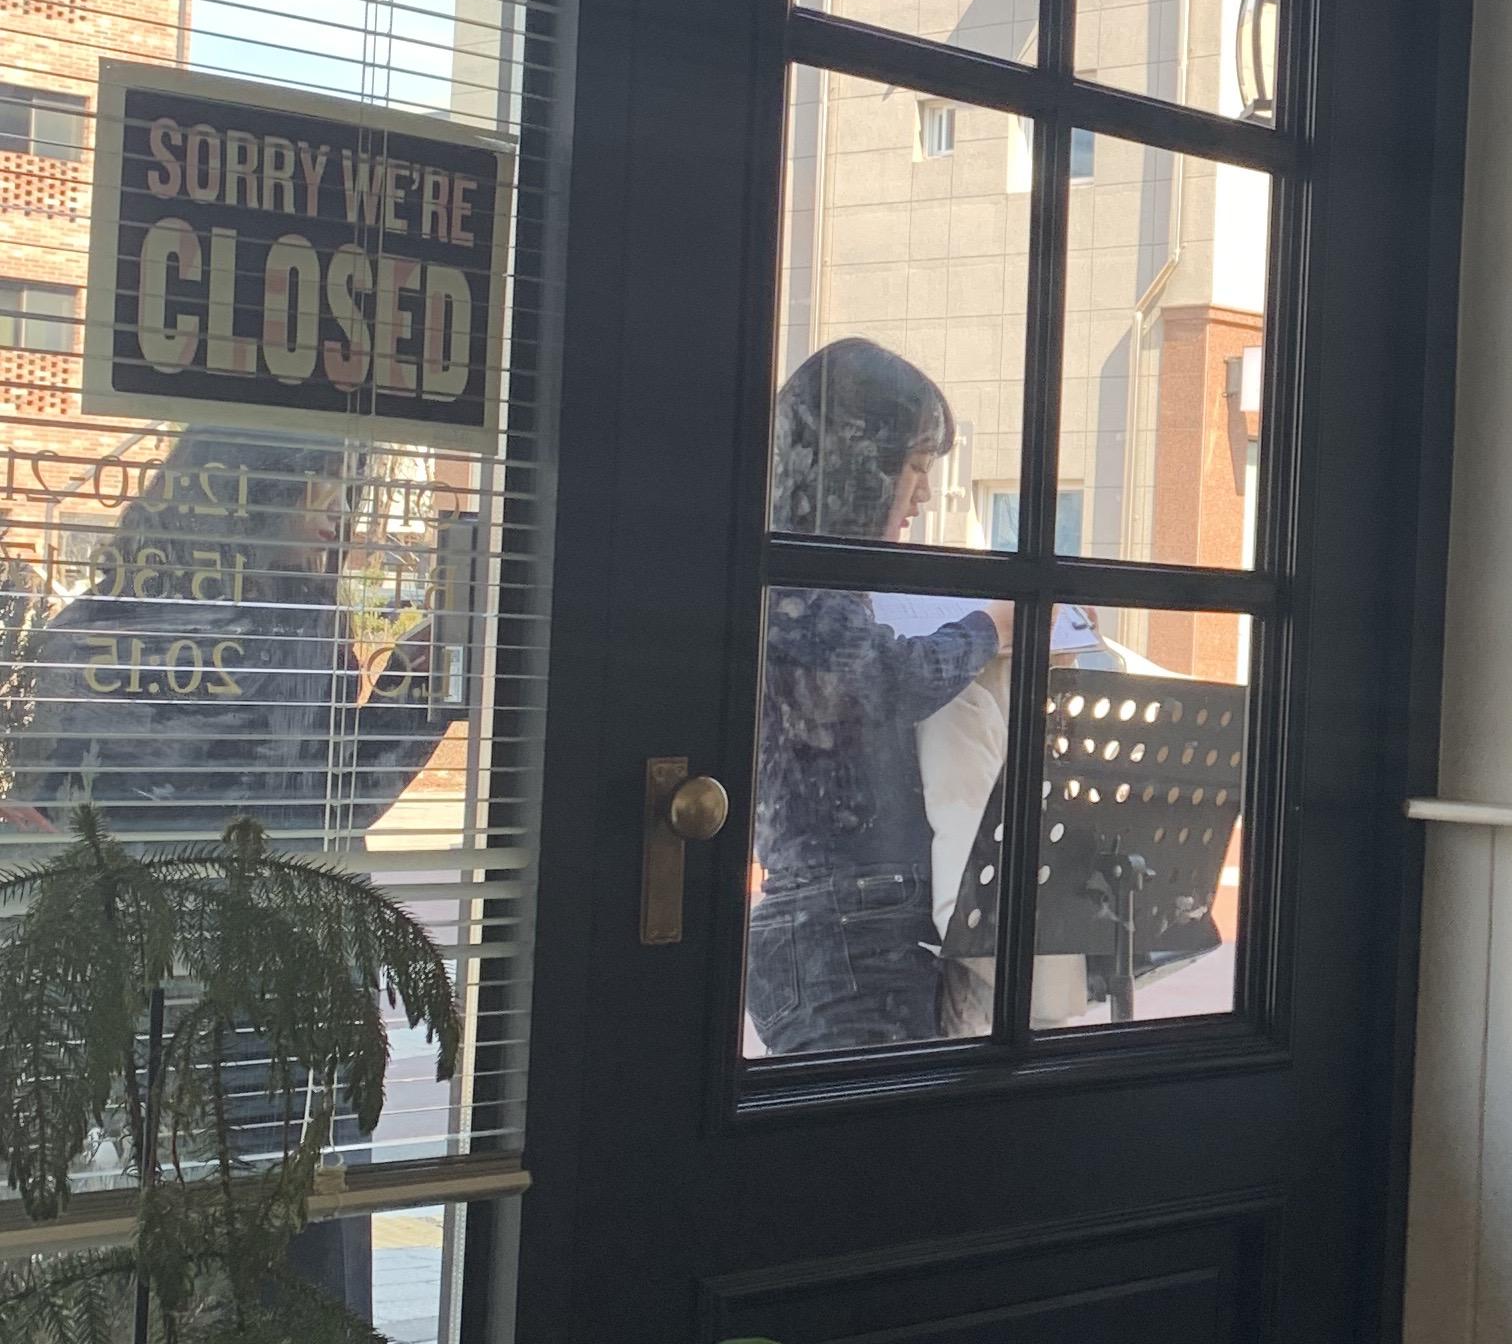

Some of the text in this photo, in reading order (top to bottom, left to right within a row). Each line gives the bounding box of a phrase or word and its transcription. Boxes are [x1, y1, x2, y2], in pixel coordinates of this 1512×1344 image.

[146, 116, 478, 248] SORRY WE'RE
[136, 216, 473, 403] CLOSED
